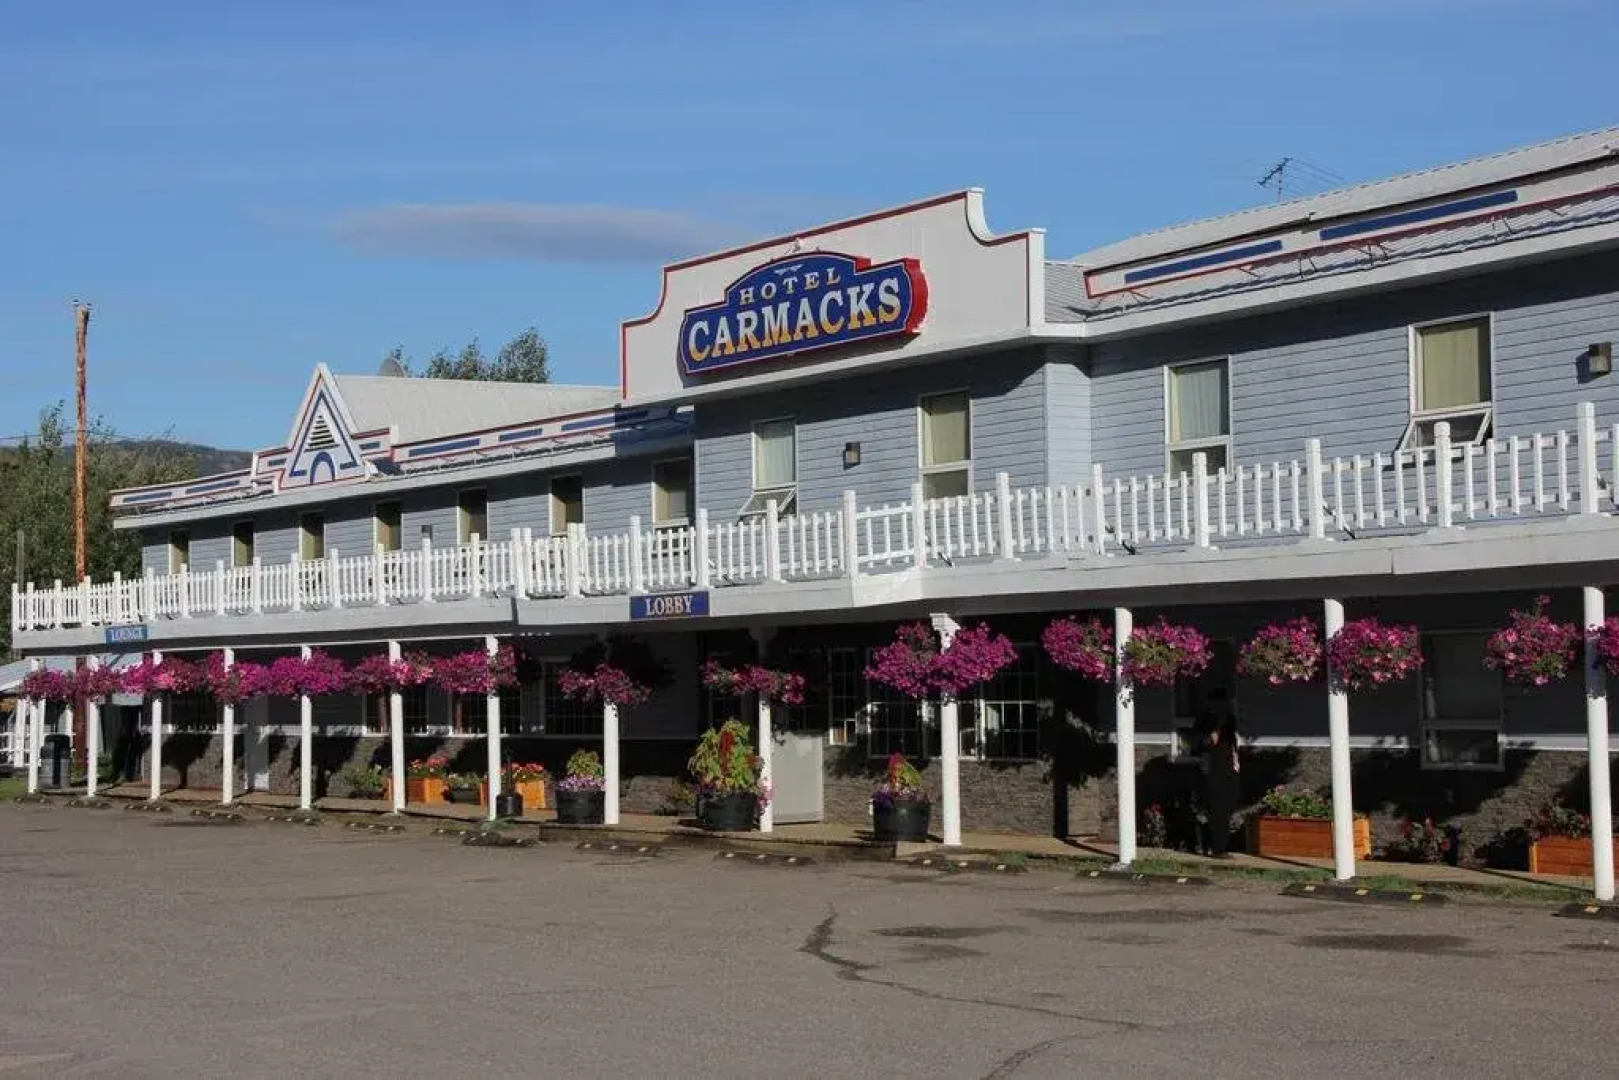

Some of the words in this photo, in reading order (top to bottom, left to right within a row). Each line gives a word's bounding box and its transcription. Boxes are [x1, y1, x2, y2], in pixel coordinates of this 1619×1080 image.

[739, 267, 841, 305] HOTEL
[688, 277, 901, 362] CARMACKS
[644, 595, 694, 616] LOBBY
